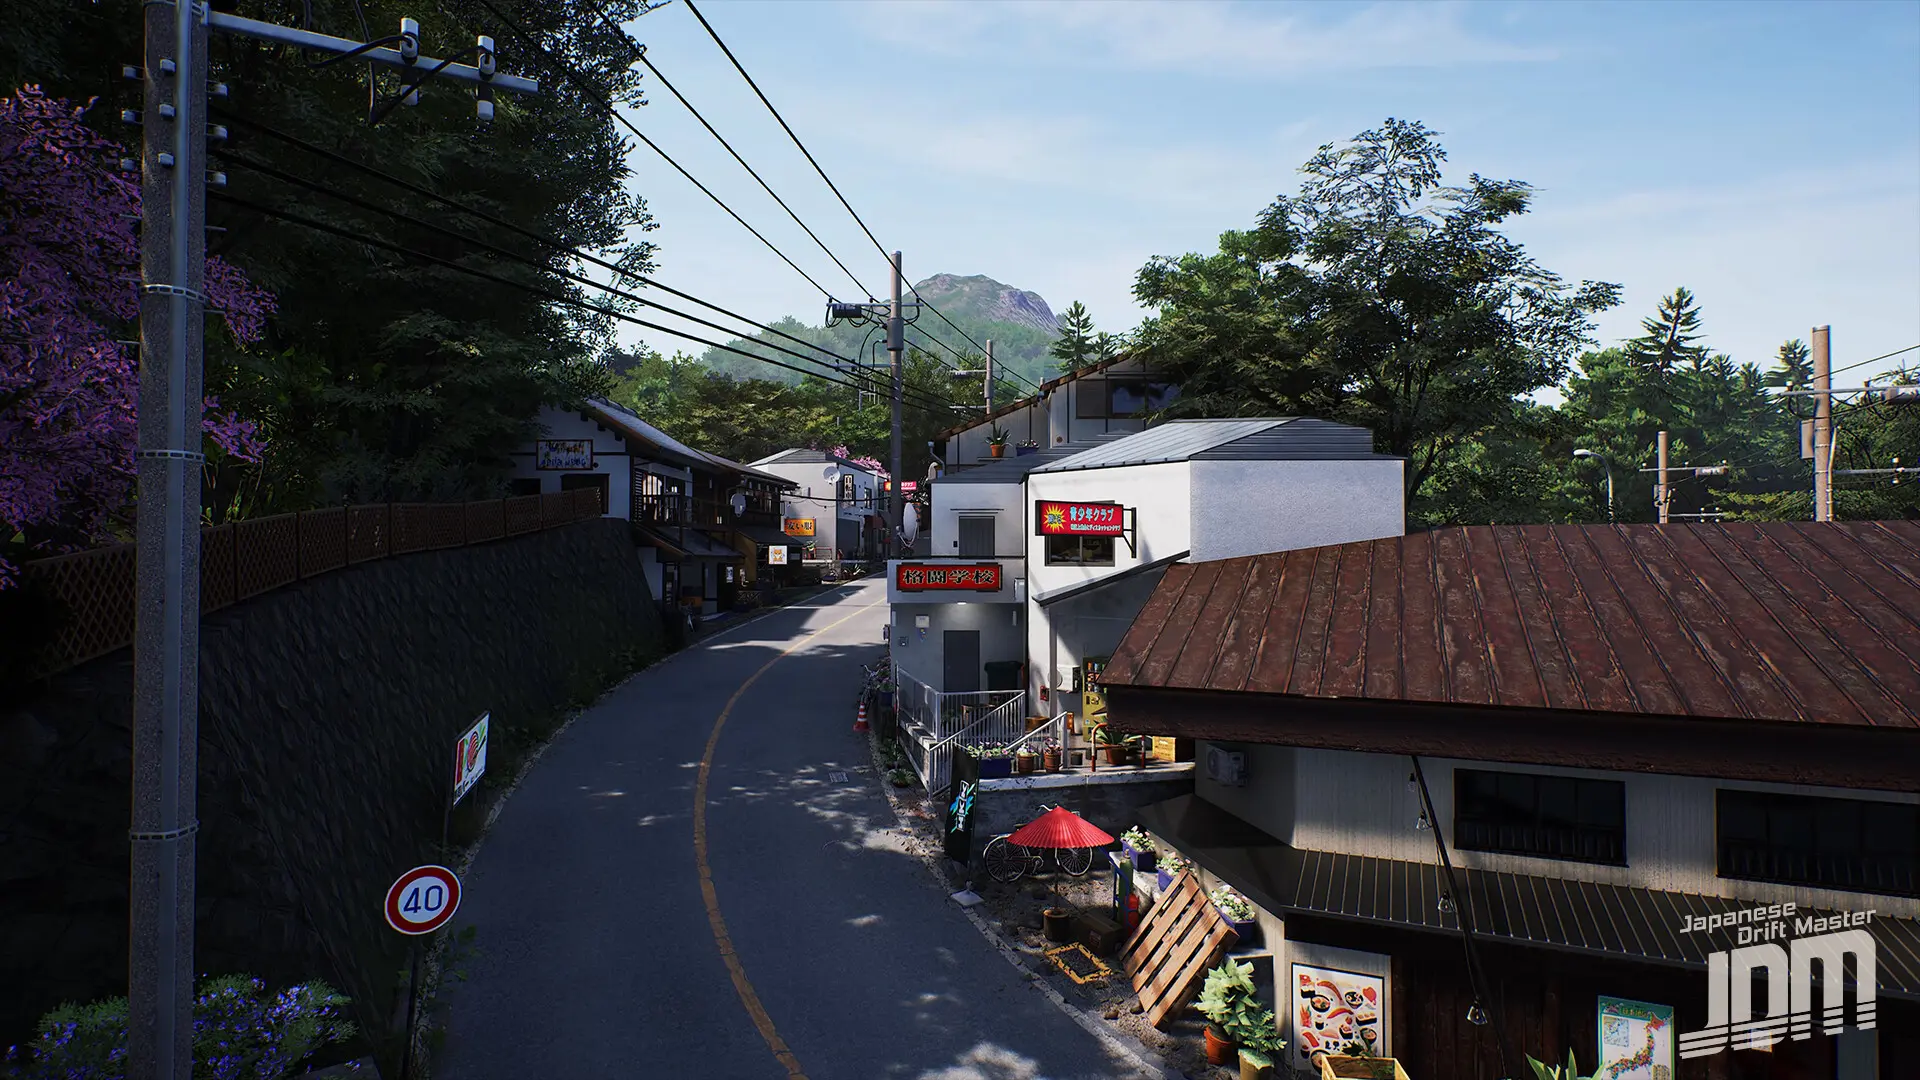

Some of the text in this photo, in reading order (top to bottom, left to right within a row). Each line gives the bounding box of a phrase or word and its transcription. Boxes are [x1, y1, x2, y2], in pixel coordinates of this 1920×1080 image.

[1069, 505, 1115, 522] 青少年クラブ
[903, 569, 995, 585] 格闘学校
[403, 885, 443, 913] 40
